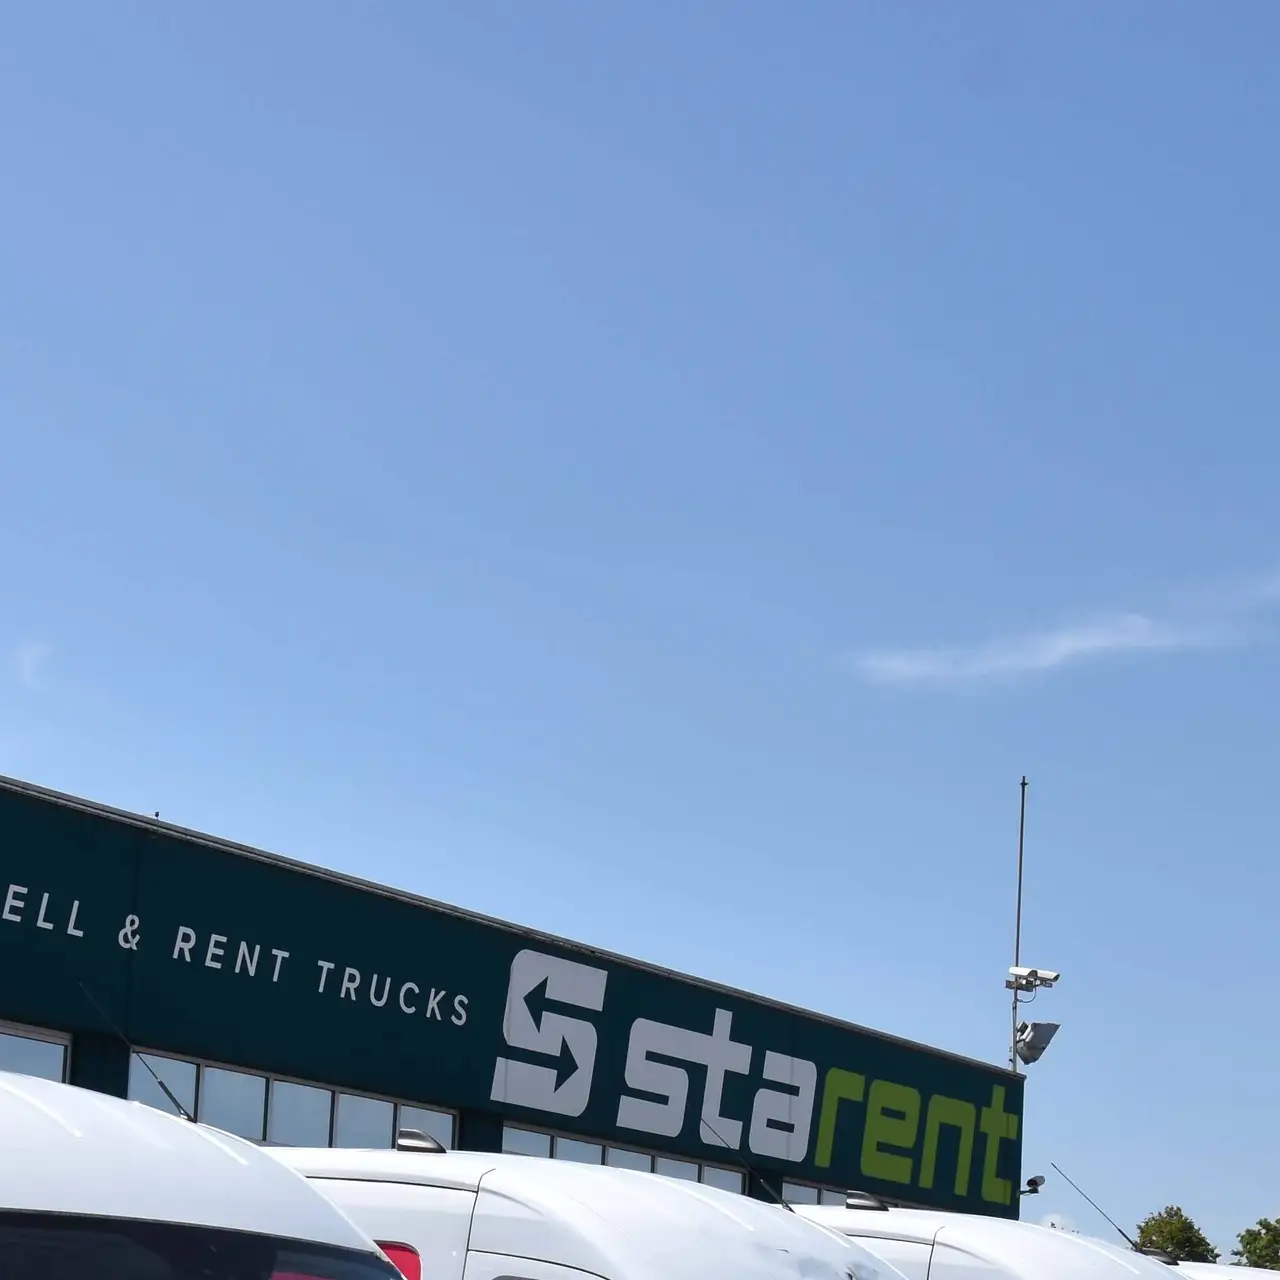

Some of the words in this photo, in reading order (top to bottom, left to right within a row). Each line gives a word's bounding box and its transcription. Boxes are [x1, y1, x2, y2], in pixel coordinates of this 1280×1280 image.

[118, 914, 141, 951] &
[172, 926, 290, 983] RENT
[316, 960, 470, 1027] TRUCKS
[616, 1007, 1018, 1206] starent
